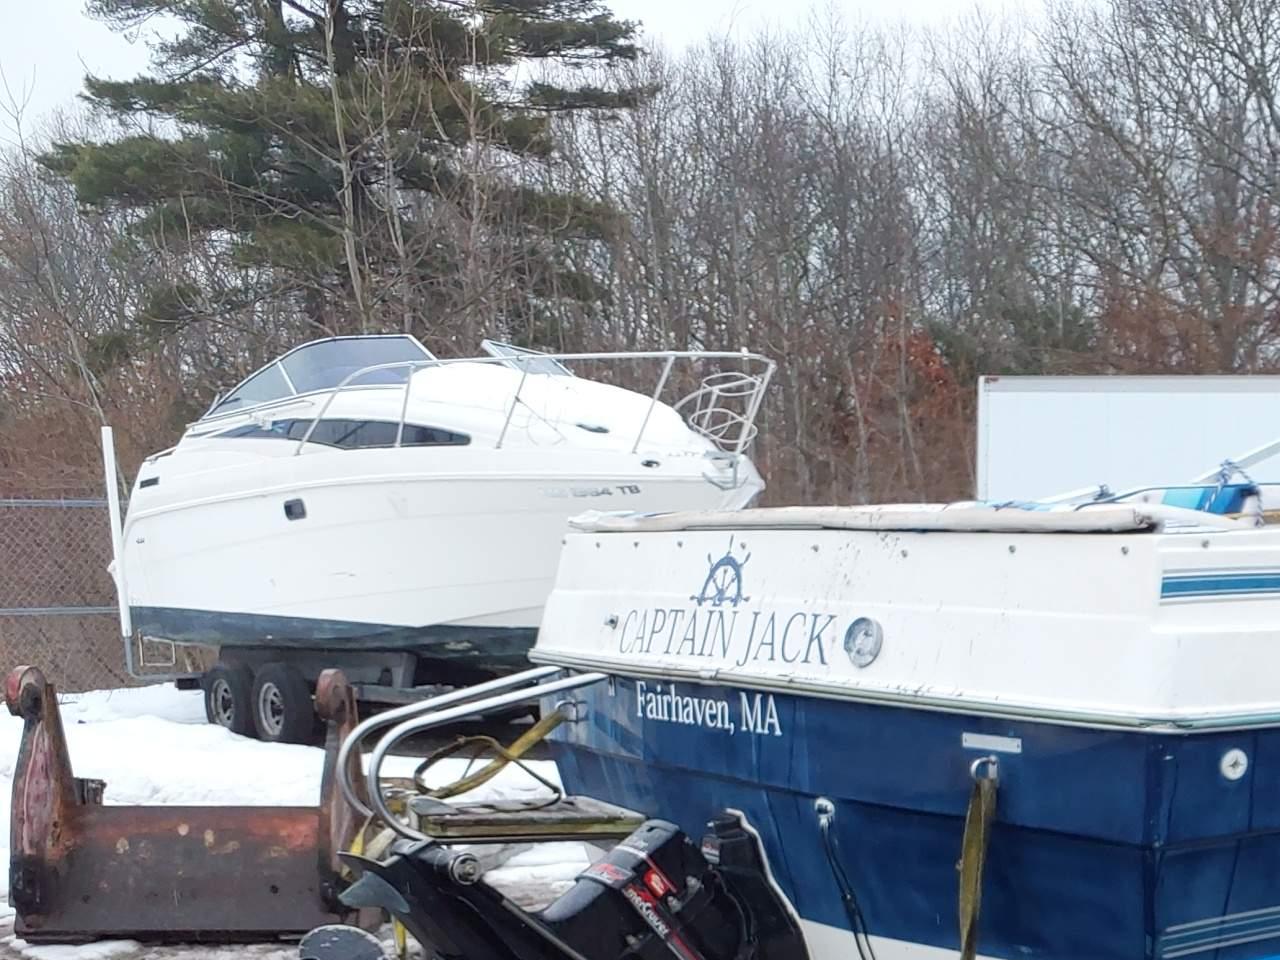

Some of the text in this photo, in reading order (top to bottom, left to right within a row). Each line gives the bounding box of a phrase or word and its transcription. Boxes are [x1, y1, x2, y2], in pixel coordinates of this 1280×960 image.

[619, 608, 838, 667] CAPTAIN JACK
[636, 680, 783, 736] Fairhaven, MA
